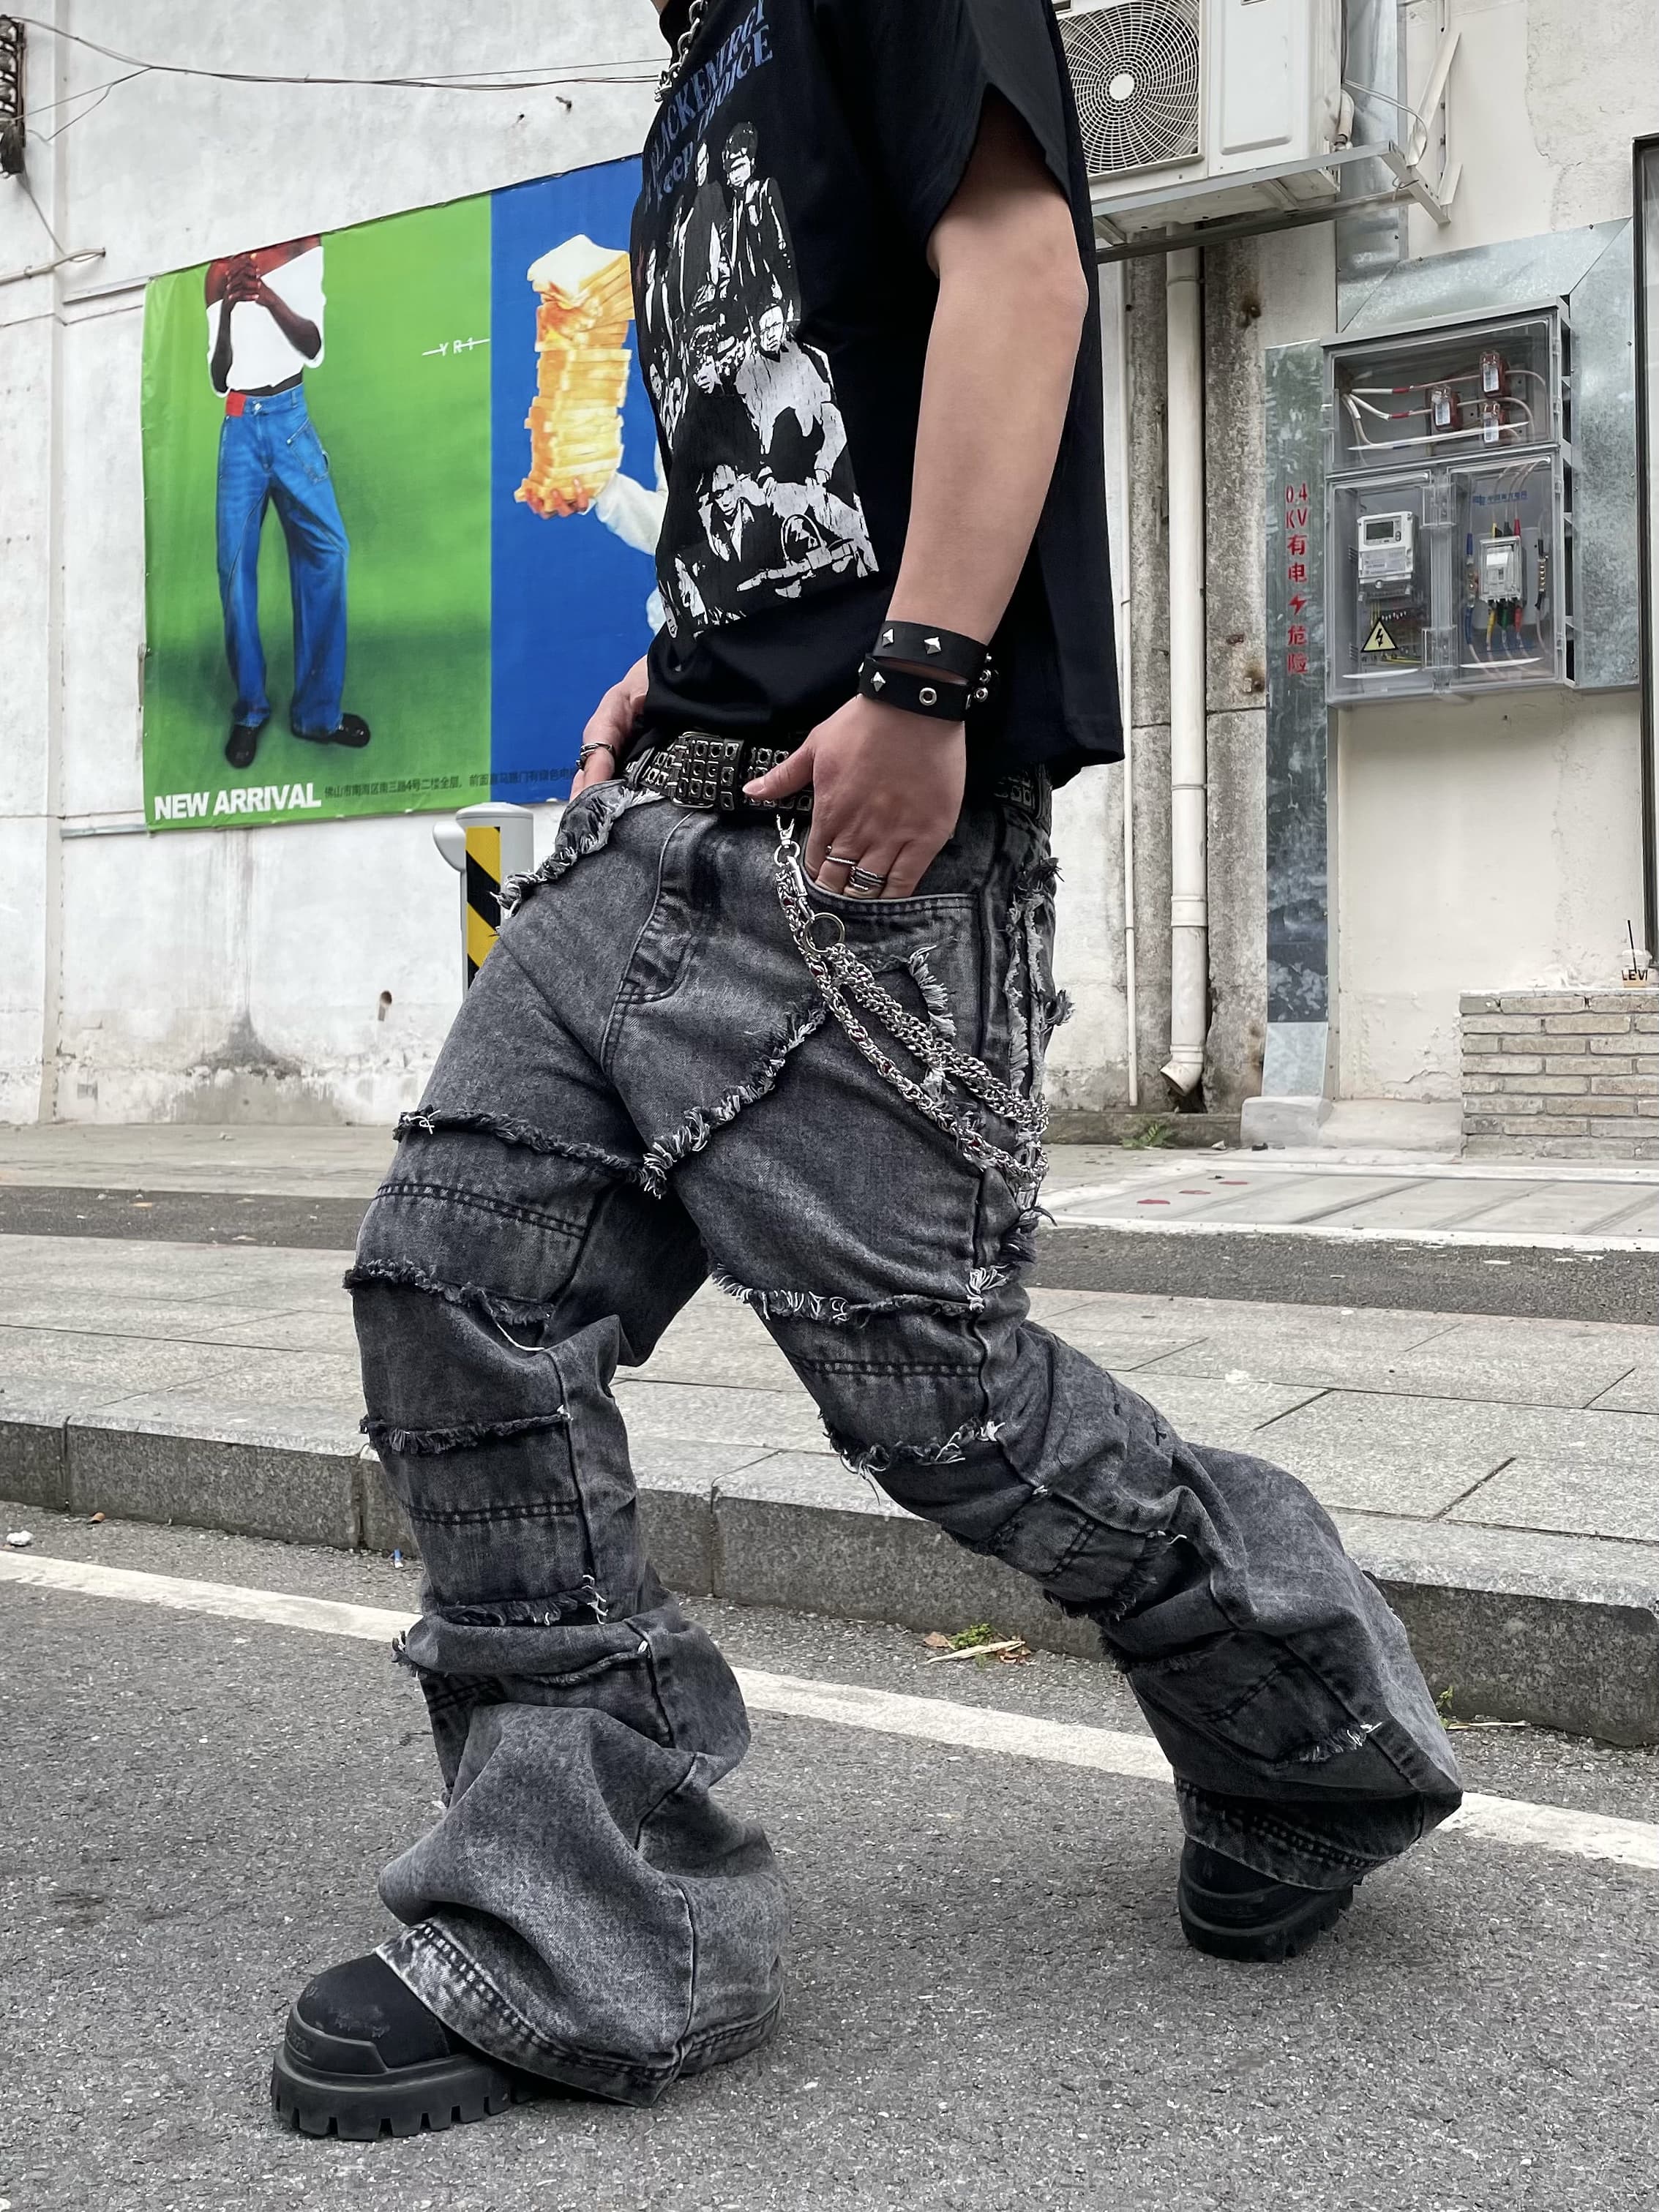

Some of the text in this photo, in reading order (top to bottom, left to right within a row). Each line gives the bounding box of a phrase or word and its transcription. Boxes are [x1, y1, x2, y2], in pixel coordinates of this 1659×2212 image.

[1286, 508, 1308, 528] KV
[154, 782, 322, 820] NEW ARRIVAL
